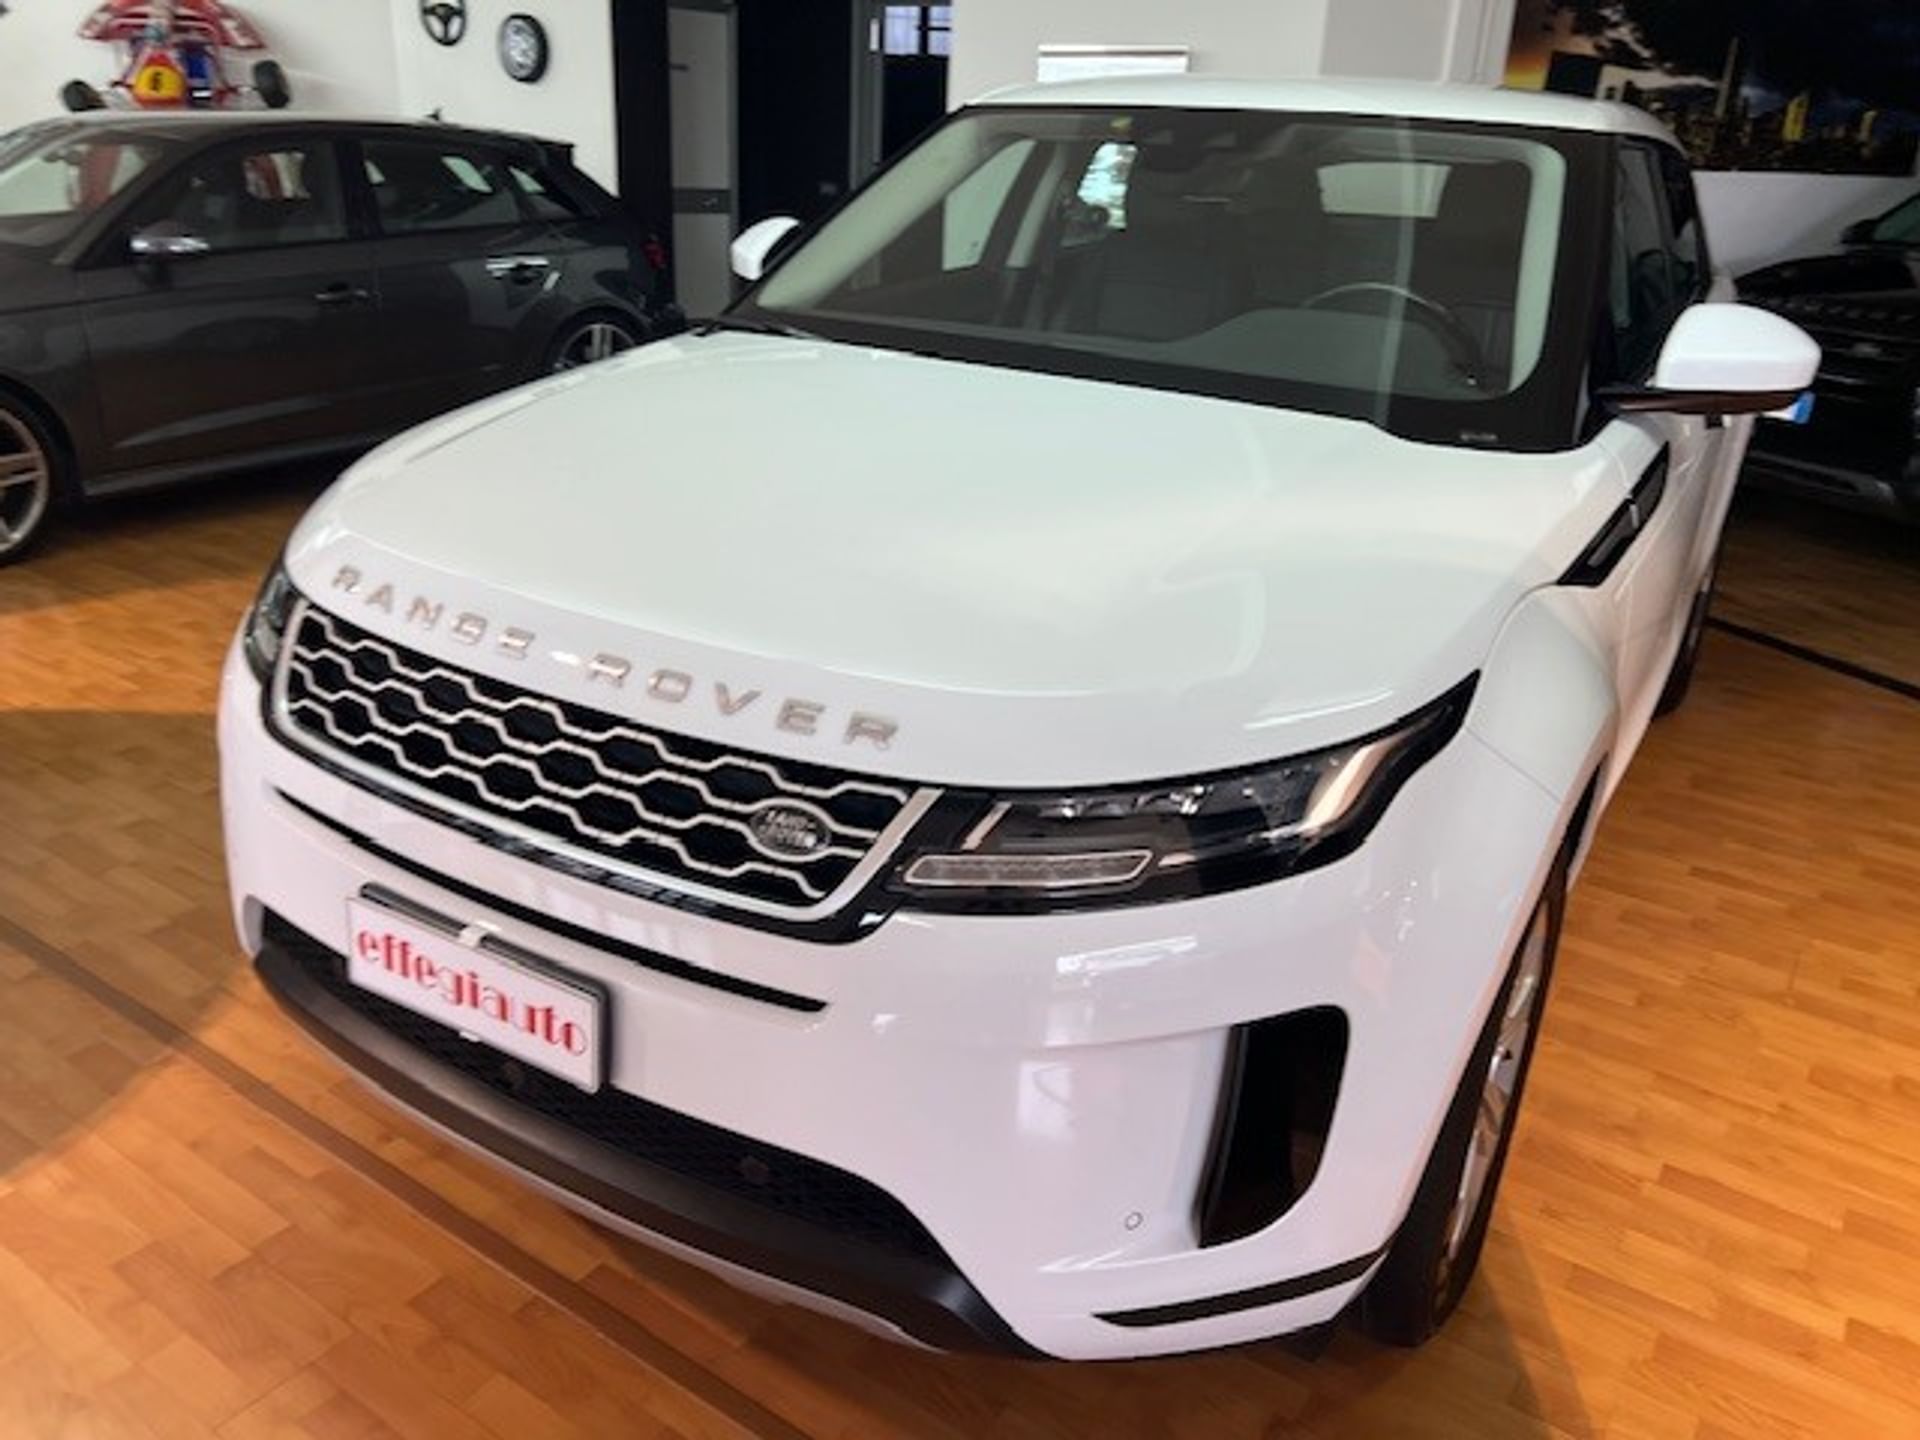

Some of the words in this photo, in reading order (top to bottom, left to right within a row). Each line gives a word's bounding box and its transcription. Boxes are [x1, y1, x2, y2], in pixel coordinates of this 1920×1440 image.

[332, 565, 535, 660] RANGE
[587, 653, 899, 750] ROVER
[357, 930, 588, 1057] effegiauto
